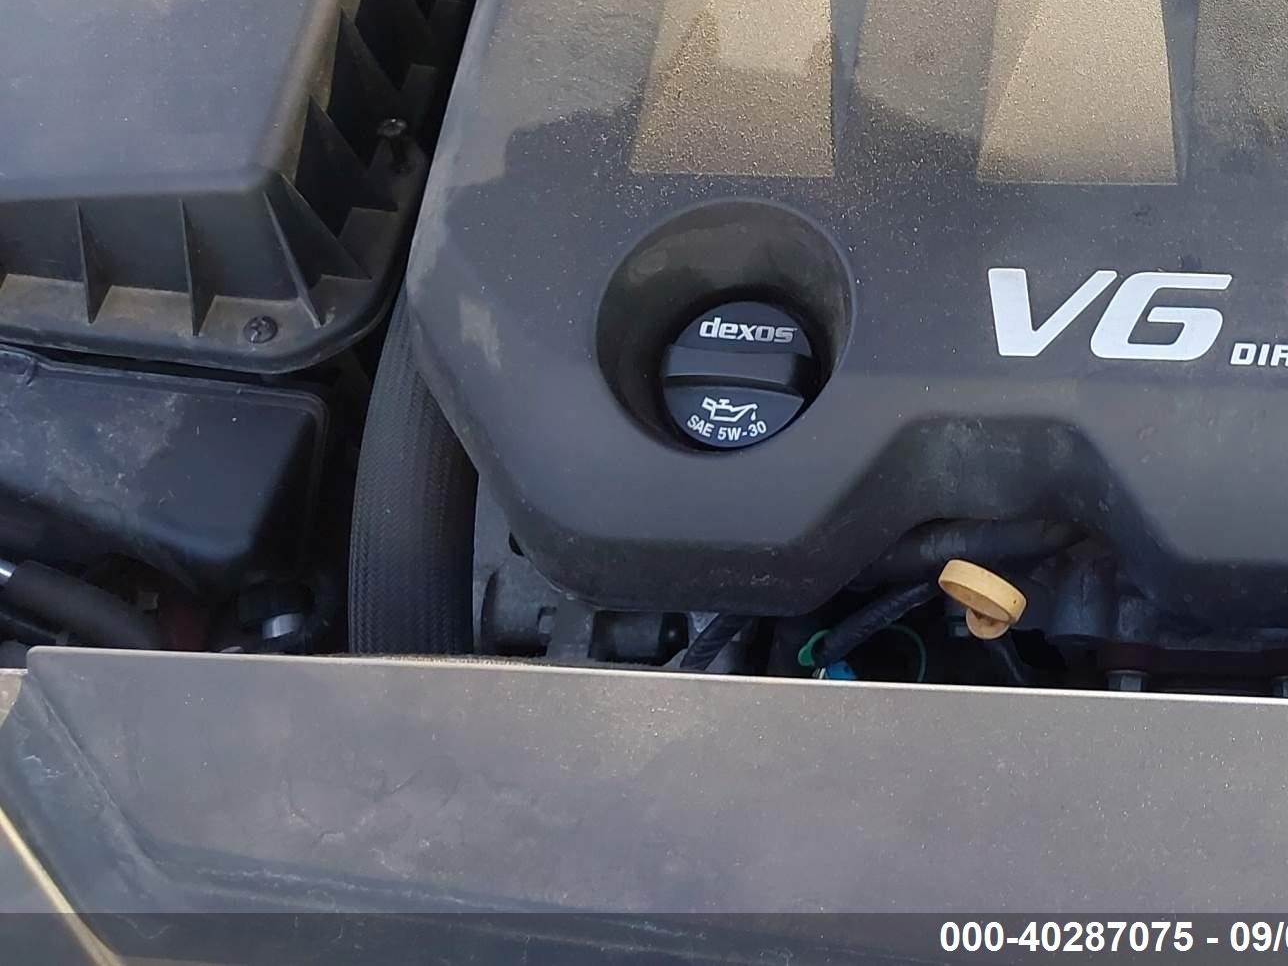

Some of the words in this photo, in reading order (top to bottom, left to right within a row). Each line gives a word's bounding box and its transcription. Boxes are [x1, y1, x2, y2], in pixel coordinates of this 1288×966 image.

[987, 267, 1233, 361] V6
[699, 317, 797, 344] dexos
[687, 414, 715, 438] SAE
[717, 420, 767, 441] 5W-30
